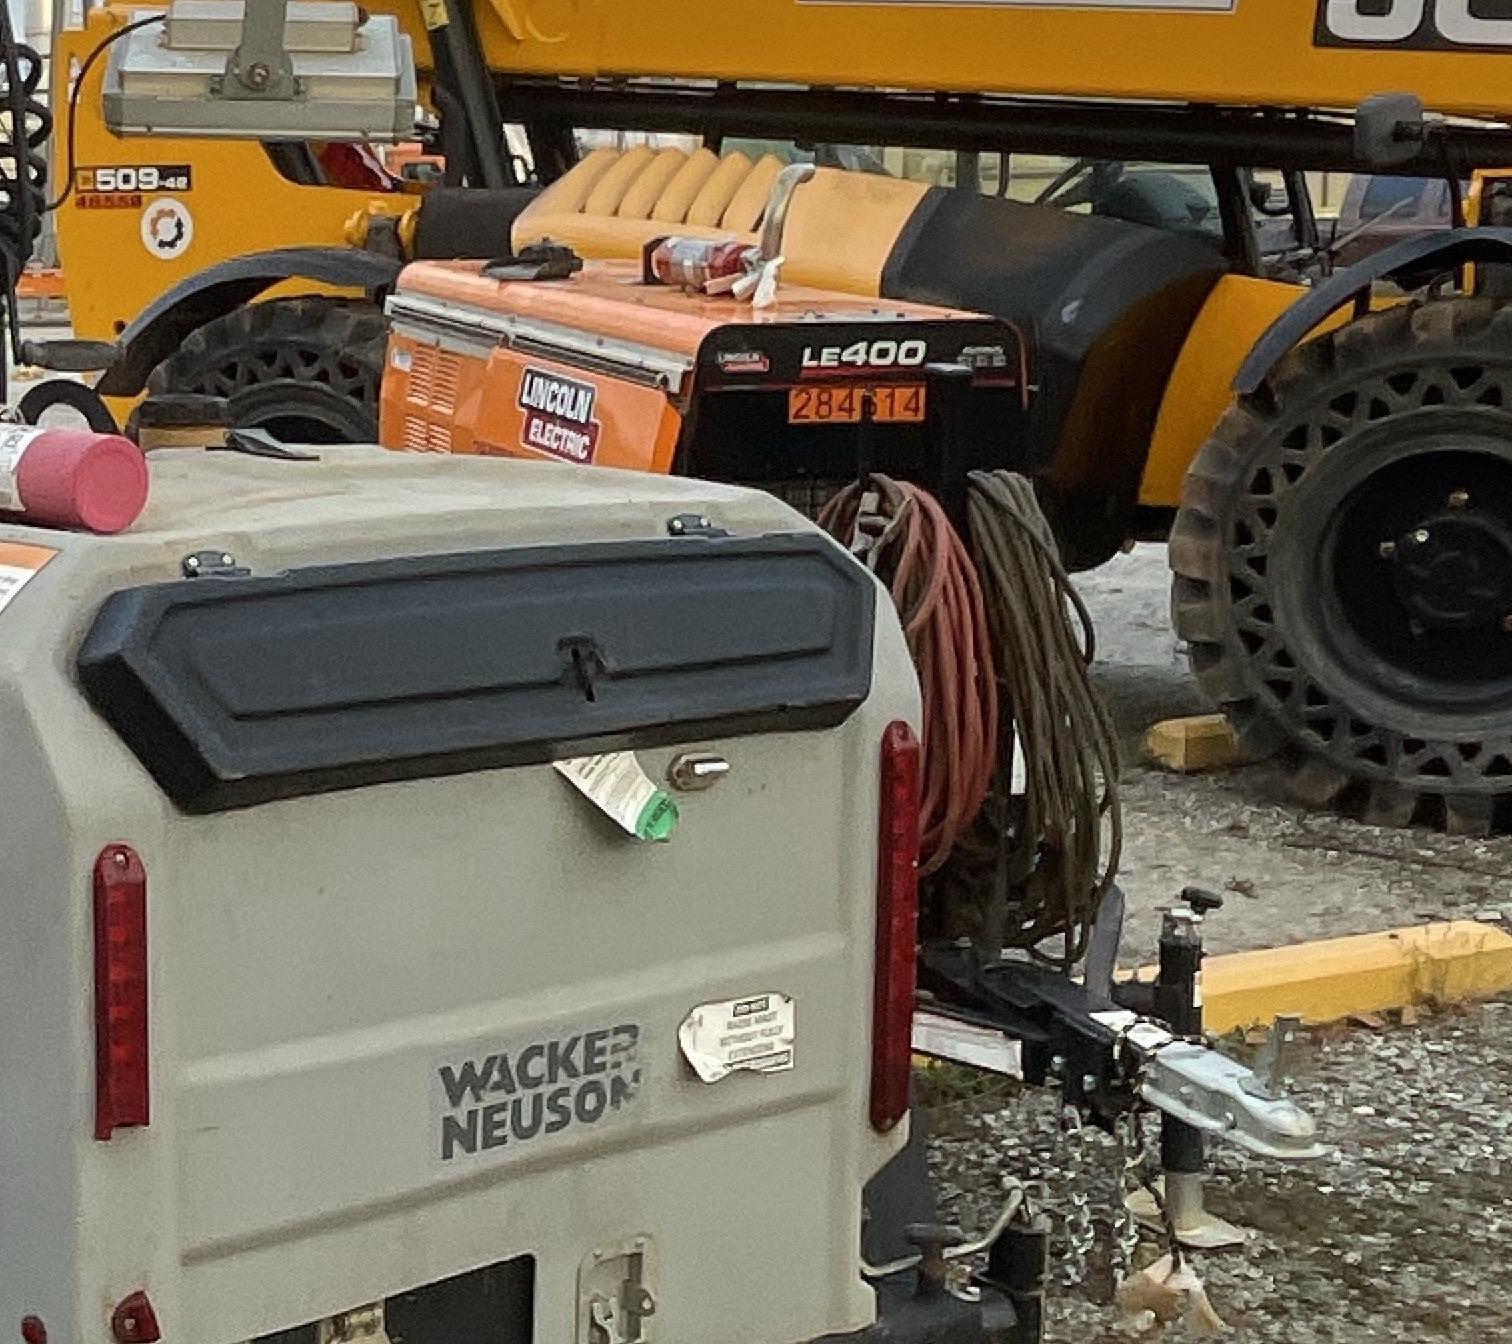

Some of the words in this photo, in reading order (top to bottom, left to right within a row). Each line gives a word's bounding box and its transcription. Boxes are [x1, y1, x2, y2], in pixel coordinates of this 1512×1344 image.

[802, 340, 926, 366] LE400
[521, 372, 592, 424] LINCOLN
[528, 418, 590, 460] ELECTRIC
